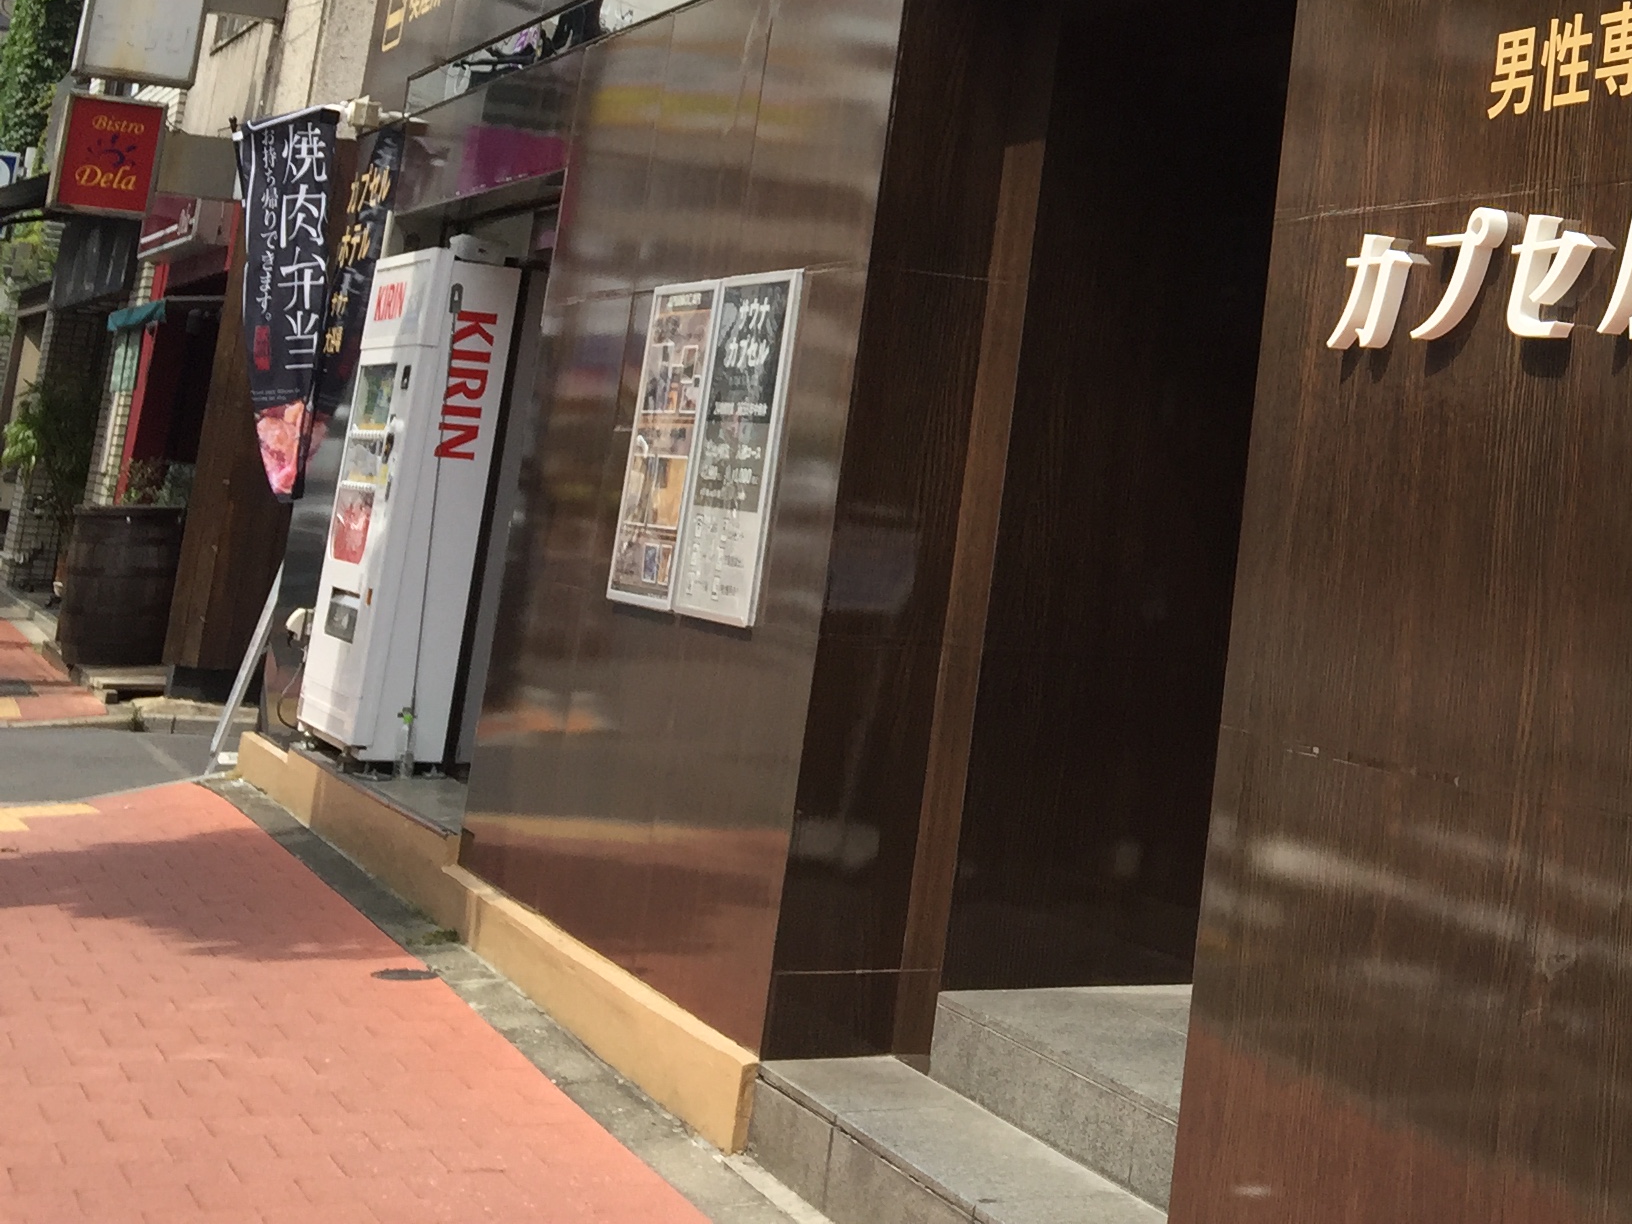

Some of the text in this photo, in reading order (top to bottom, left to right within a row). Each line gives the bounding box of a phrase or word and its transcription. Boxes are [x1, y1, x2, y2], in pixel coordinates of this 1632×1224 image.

[92, 114, 145, 136] Bistro
[74, 163, 138, 191] Dela
[278, 120, 328, 370] 焼肉弁当
[374, 280, 408, 323] KIRIN
[434, 309, 499, 462] KIRIN
